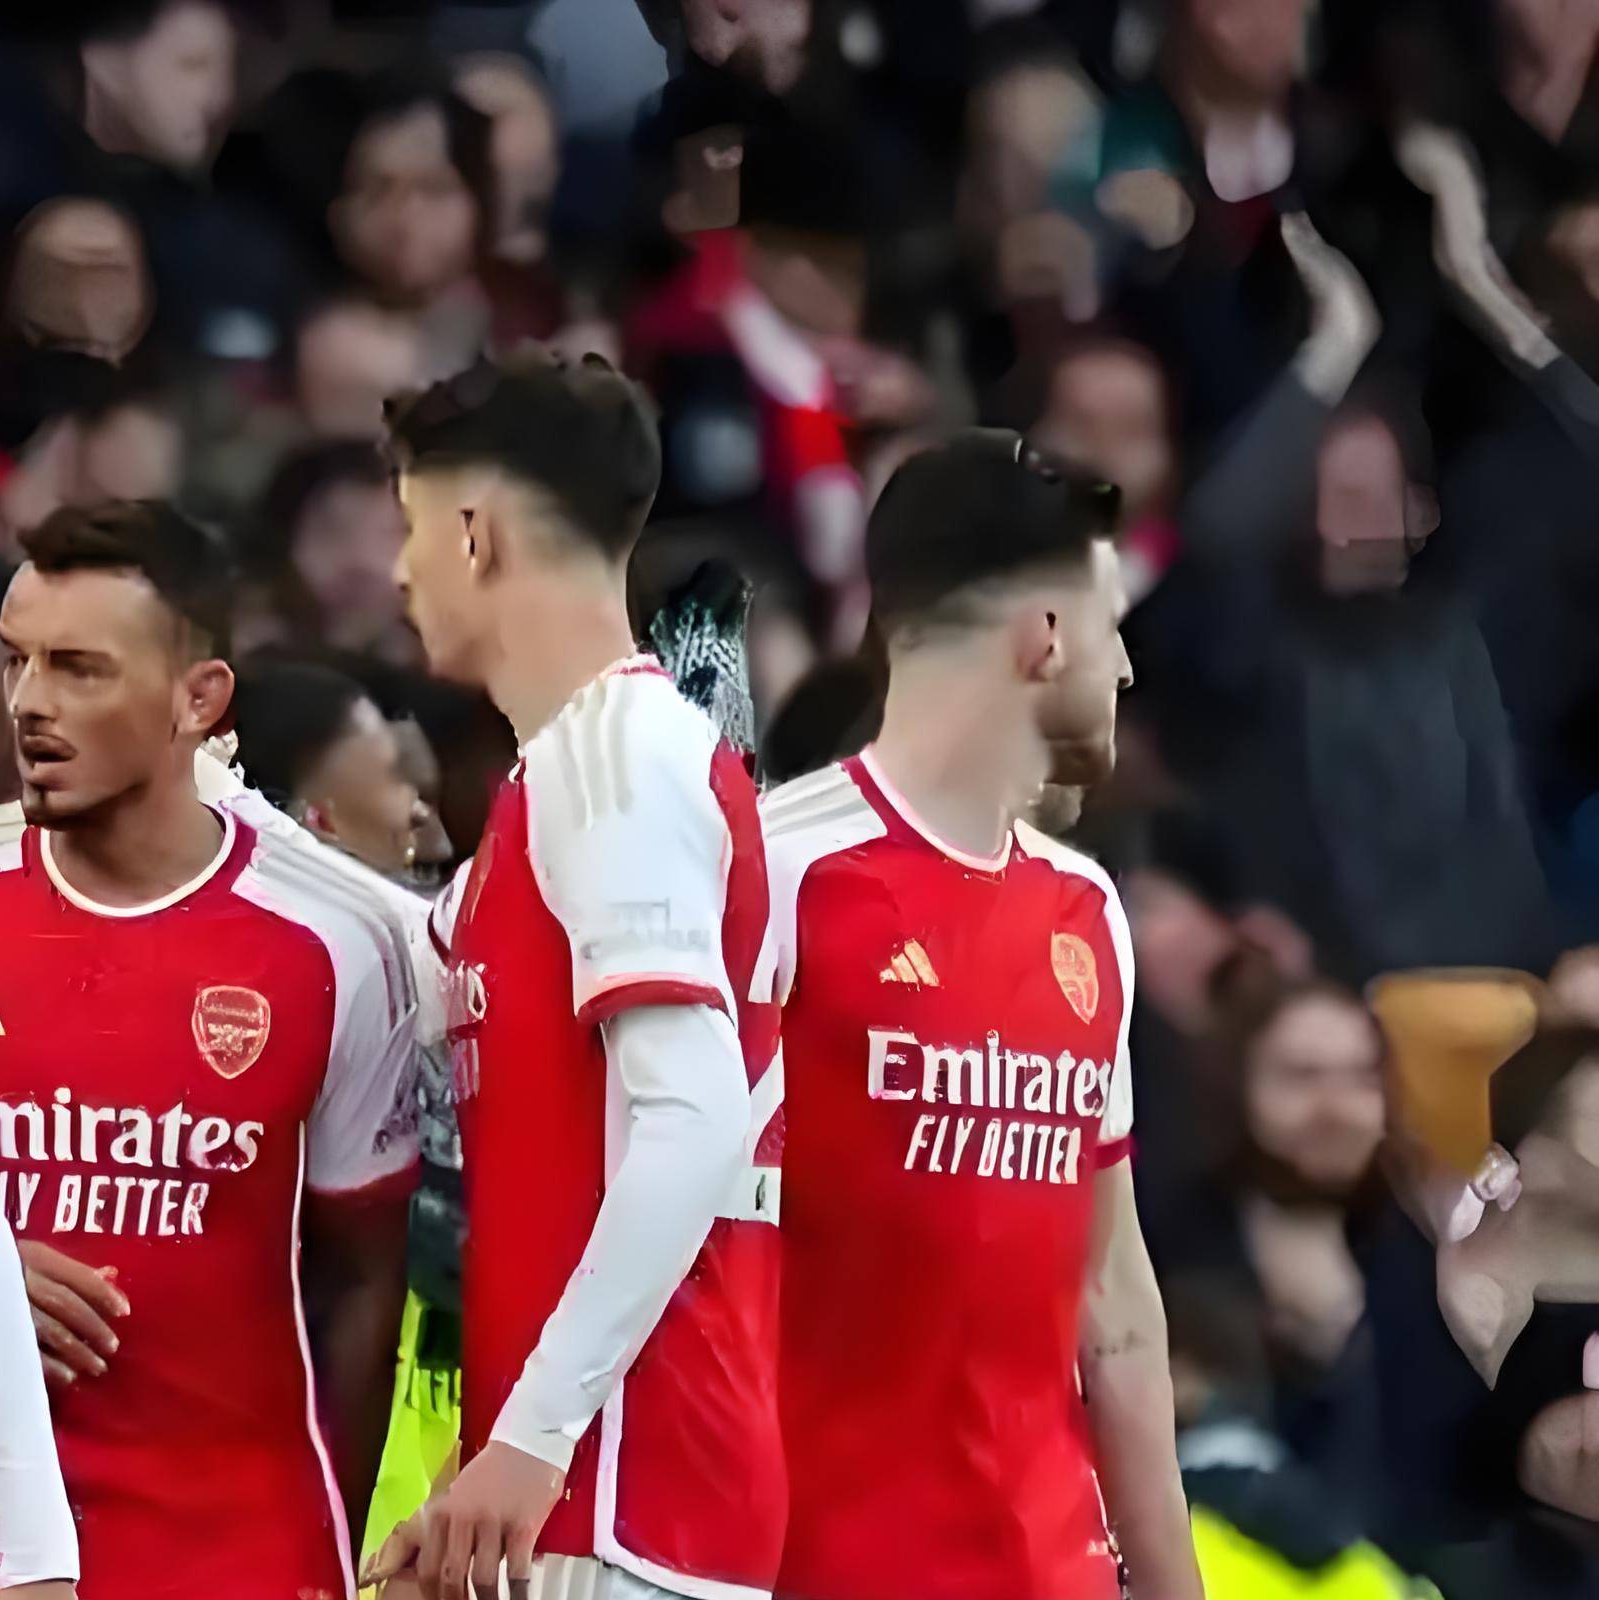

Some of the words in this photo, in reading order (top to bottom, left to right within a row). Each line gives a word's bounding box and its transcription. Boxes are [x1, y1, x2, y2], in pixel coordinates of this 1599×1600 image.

[867, 1026, 1111, 1118] Emirates
[904, 1113, 976, 1175] FLY
[52, 1174, 210, 1237] BETTER
